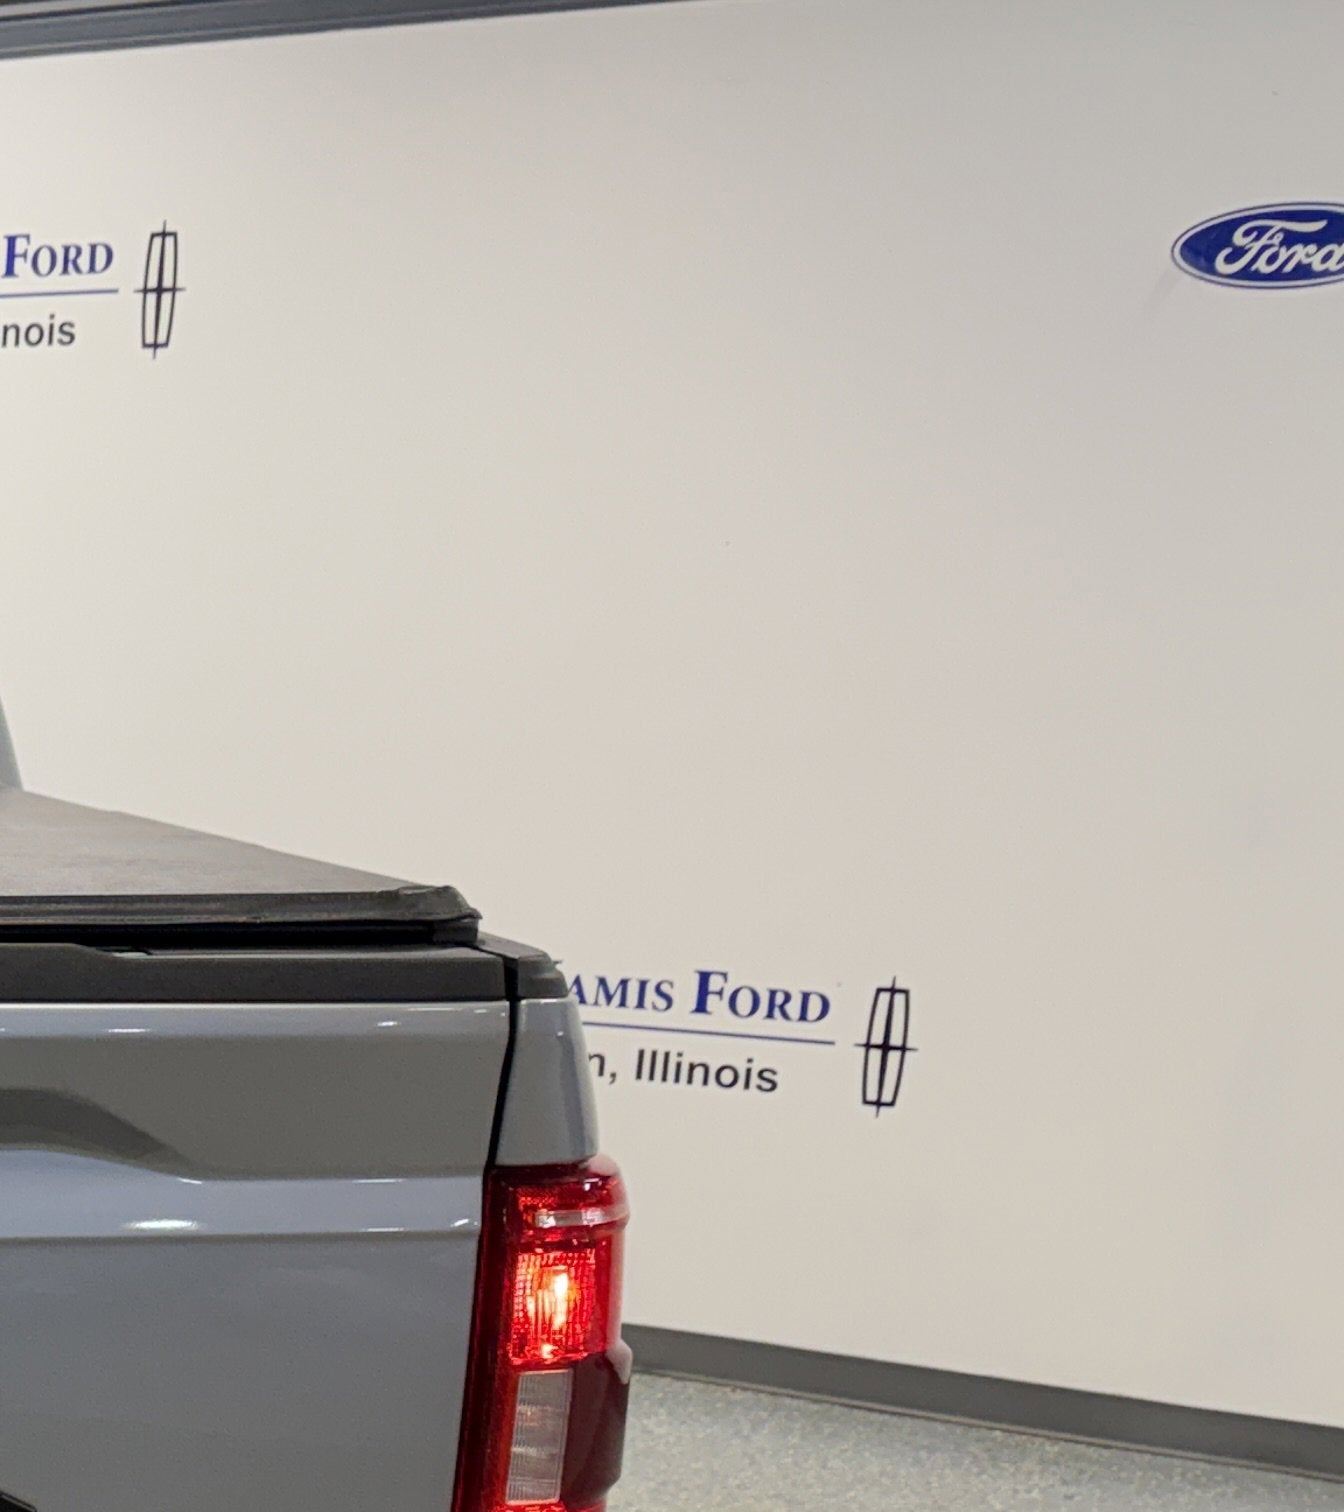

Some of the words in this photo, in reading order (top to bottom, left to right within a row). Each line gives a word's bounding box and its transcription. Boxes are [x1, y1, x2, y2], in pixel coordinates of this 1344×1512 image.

[1, 233, 114, 279] FORD
[568, 973, 675, 1013] AMIS
[690, 968, 831, 1024] FORD
[634, 1048, 780, 1094] Illinois
